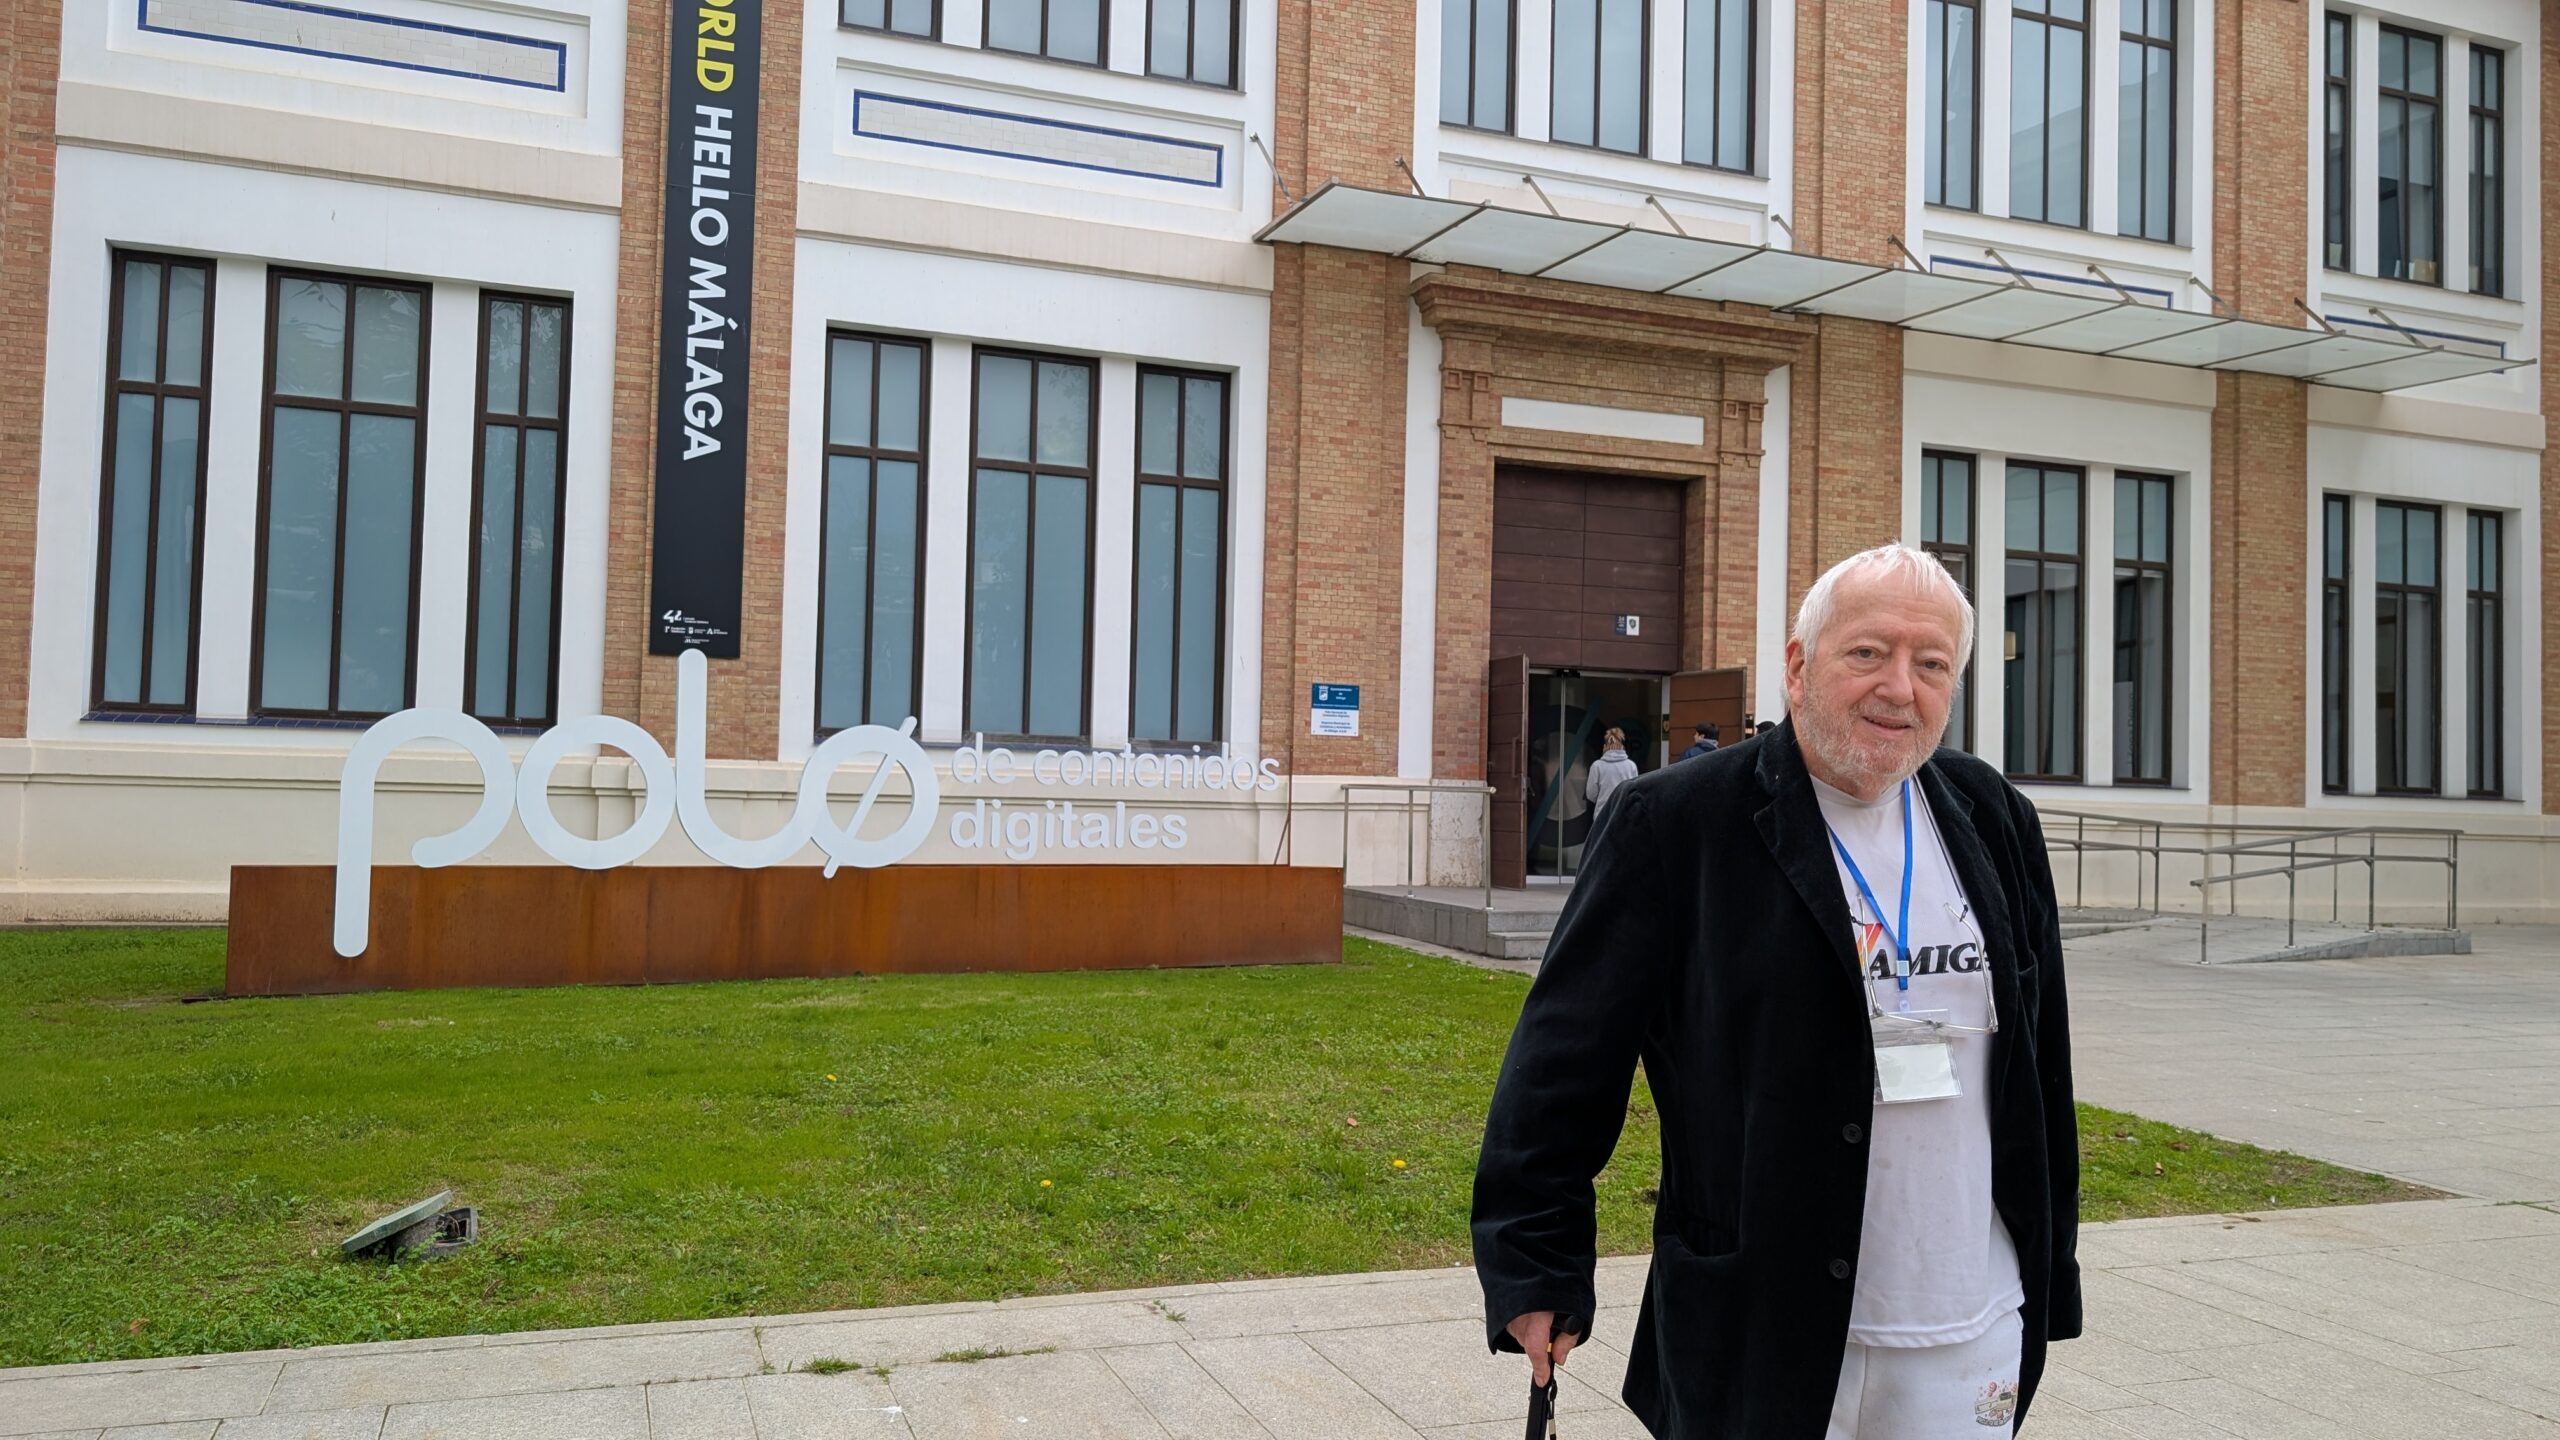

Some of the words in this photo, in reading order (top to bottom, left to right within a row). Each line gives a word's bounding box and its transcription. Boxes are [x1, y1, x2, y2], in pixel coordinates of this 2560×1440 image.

[696, 0, 736, 92] RLD
[690, 104, 733, 246] HELLO
[683, 257, 738, 461] MÁLAGA
[952, 732, 1016, 785] de
[1033, 742, 1280, 791] contenidos
[950, 798, 1188, 861] digitales
[1863, 942, 1992, 981] AMIG
